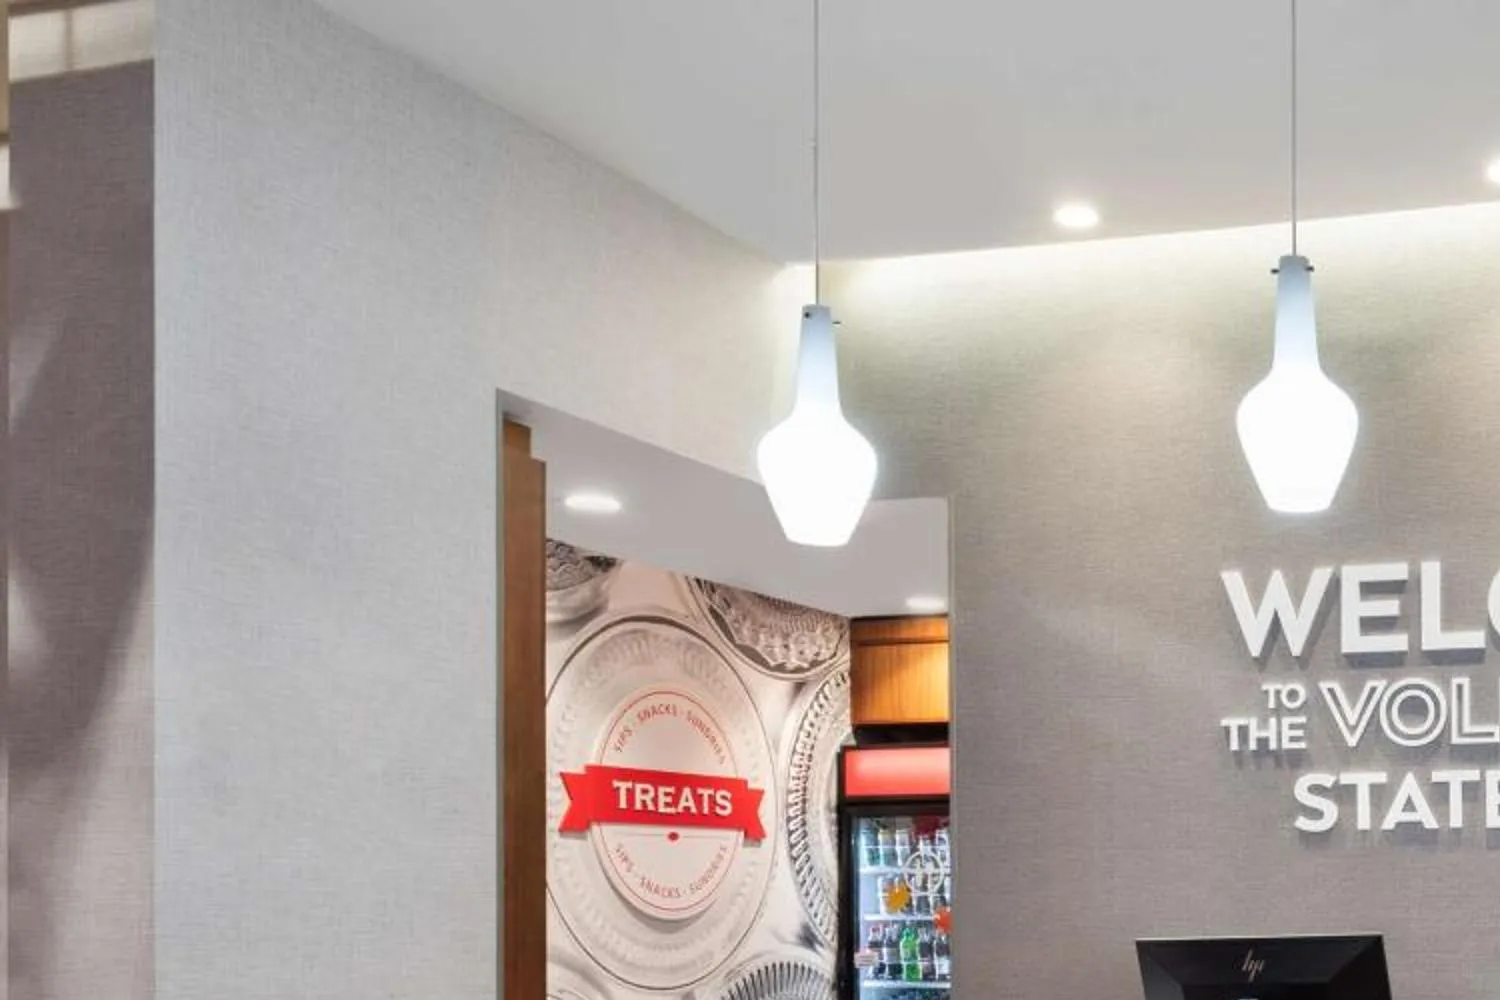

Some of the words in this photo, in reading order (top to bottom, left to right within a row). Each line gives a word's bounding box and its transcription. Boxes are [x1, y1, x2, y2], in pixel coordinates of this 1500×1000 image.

[1262, 683, 1305, 710] TO
[636, 703, 678, 723] SNACKS
[1221, 716, 1307, 752] THE
[611, 779, 734, 817] TREATS
[640, 874, 682, 898] SNACKS
[1242, 949, 1265, 983] hp
